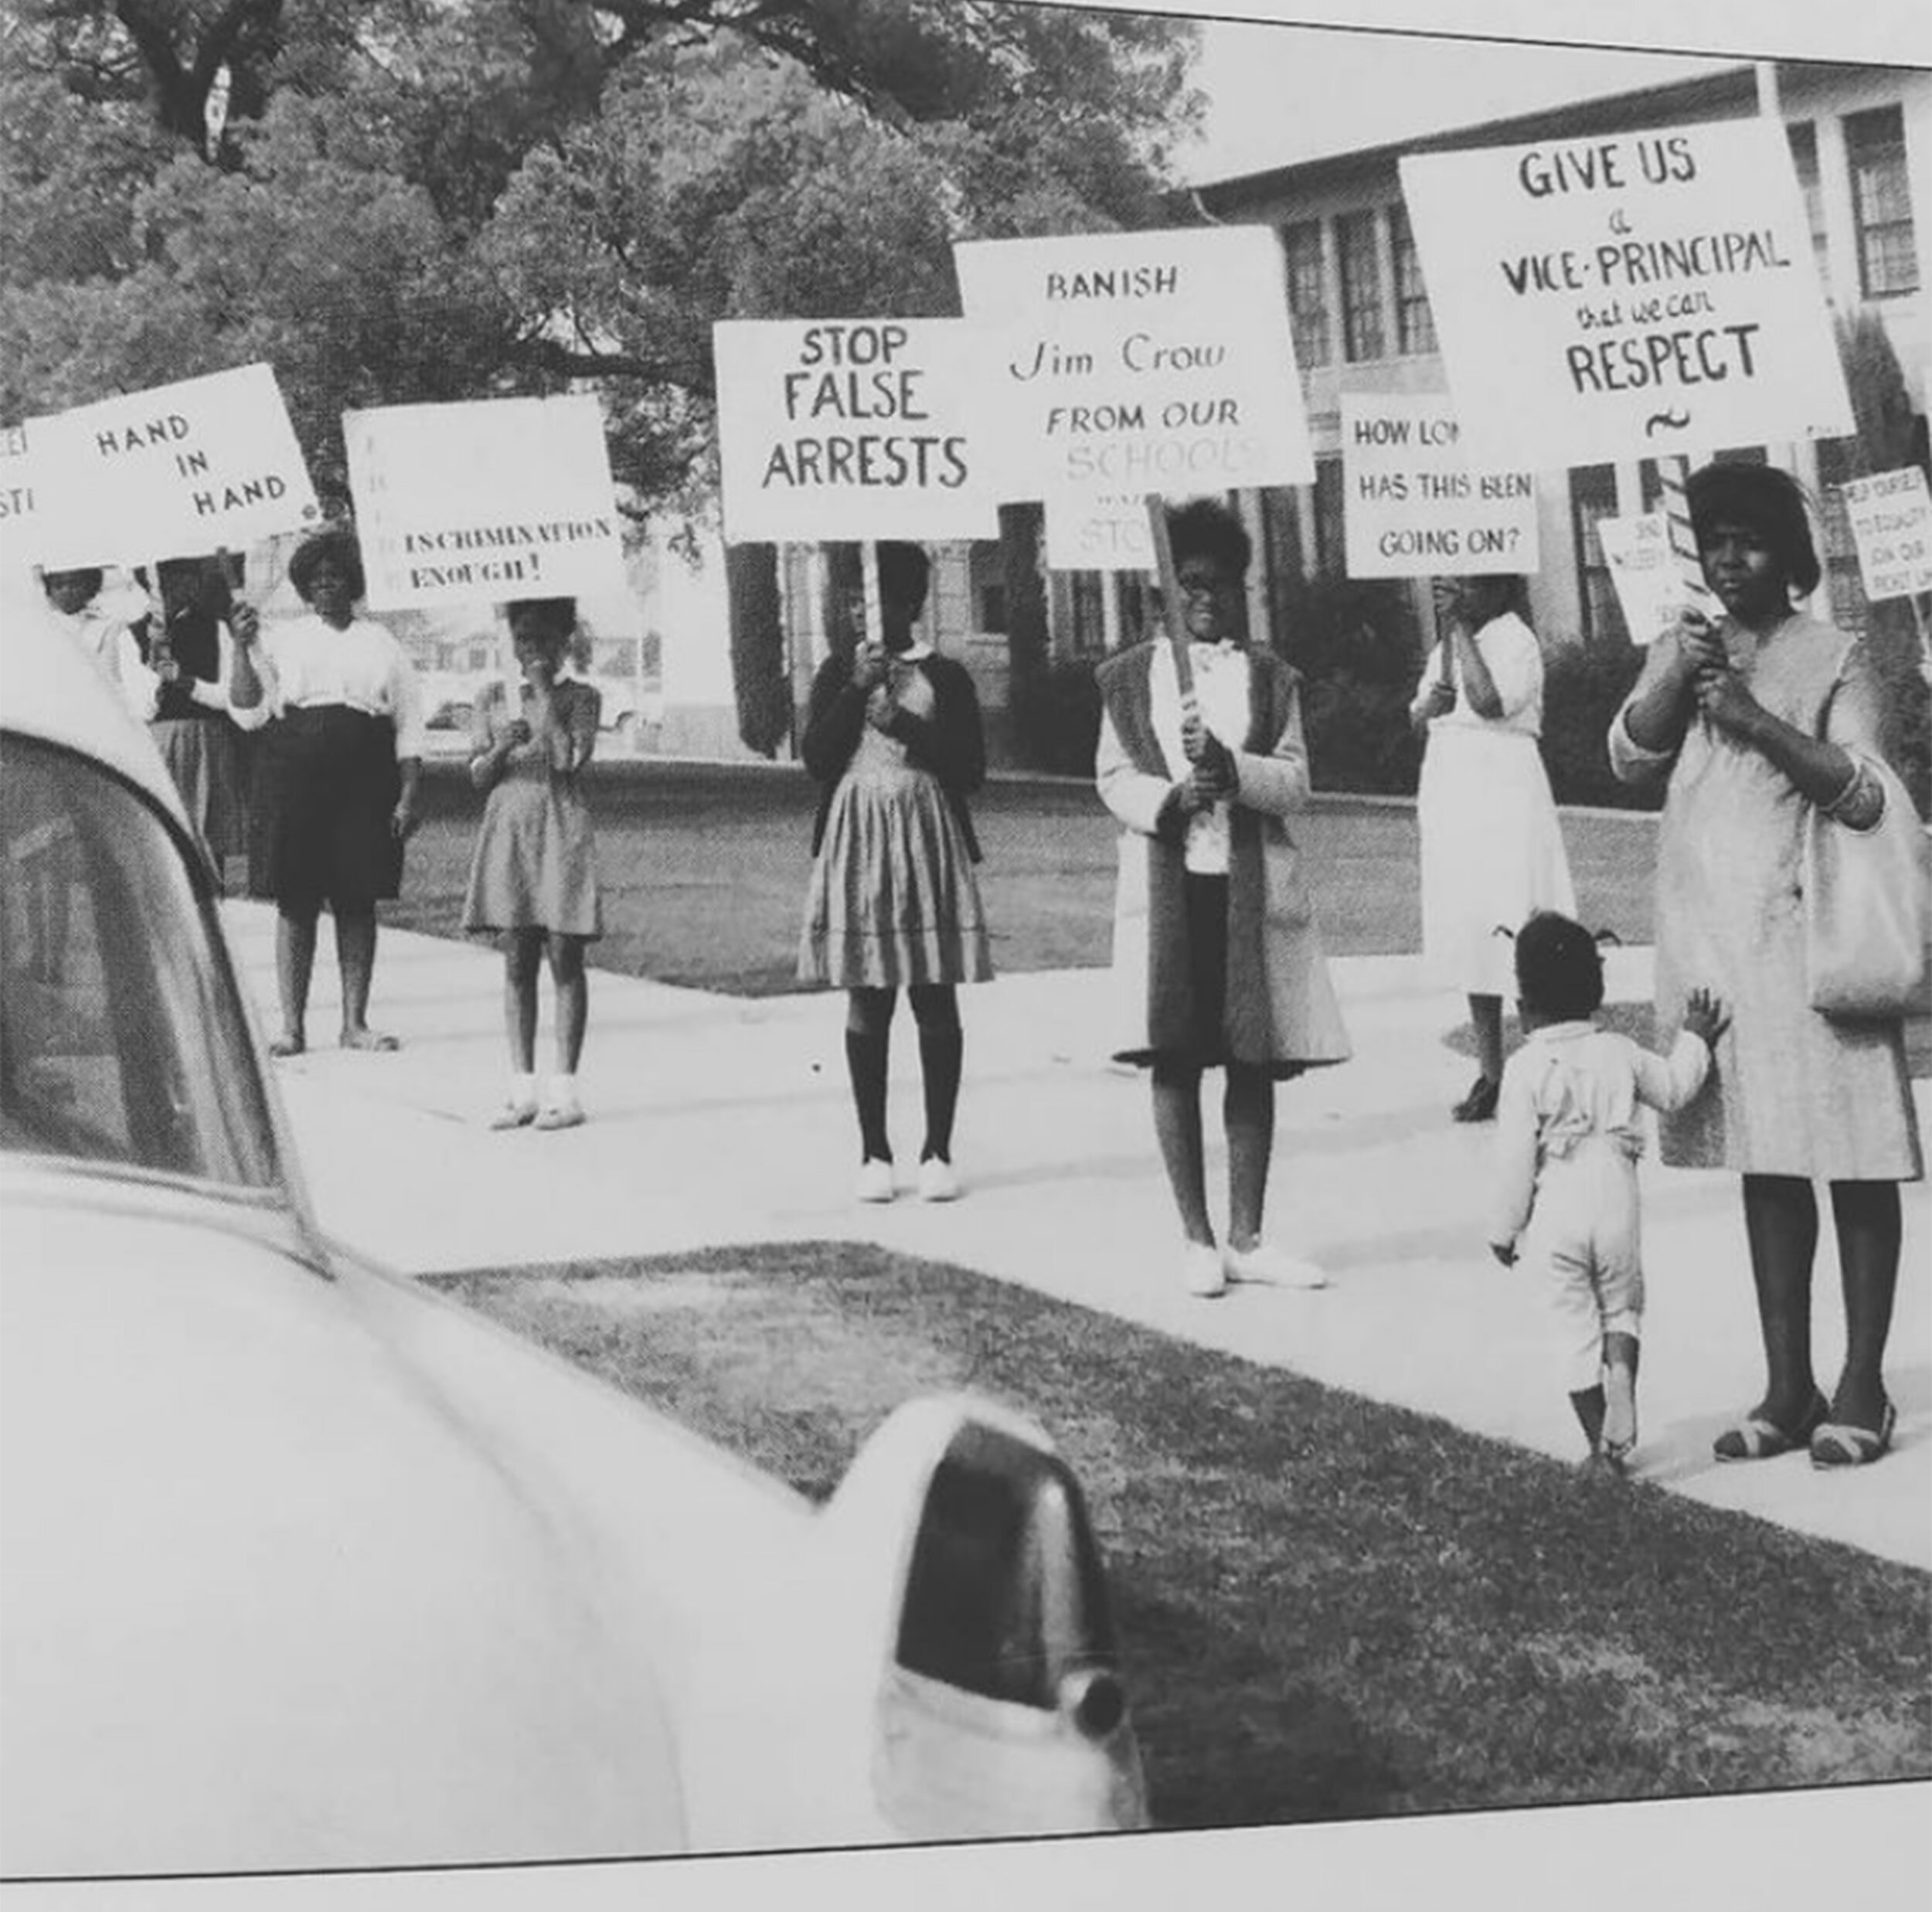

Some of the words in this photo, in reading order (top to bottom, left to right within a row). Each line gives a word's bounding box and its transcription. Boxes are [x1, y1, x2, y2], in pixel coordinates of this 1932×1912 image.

[1518, 143, 1626, 199] GIVE
[1637, 137, 1696, 185] US
[1609, 209, 1632, 235] a
[1046, 265, 1178, 300] BANISH
[1577, 301, 1624, 330] that
[1630, 298, 1663, 325] we
[1665, 290, 1716, 319] can
[800, 325, 909, 366] STOP
[1009, 342, 1094, 382] Jim
[1122, 333, 1226, 373] Crow
[1566, 324, 1760, 393] RESPECT
[784, 369, 930, 421] FALSE
[96, 414, 196, 456] HAND
[1046, 404, 1146, 435] FROM
[1162, 398, 1240, 429] OUR
[1354, 418, 1411, 447] HOW
[175, 450, 209, 478] IN
[762, 434, 968, 489] ARRESTS
[192, 475, 287, 516] HAND
[1359, 472, 1410, 502] HAS
[1416, 472, 1471, 500] THIS
[1479, 472, 1532, 501] BEEN
[1378, 529, 1461, 559] GOING
[1466, 526, 1522, 556] ON?
[410, 551, 542, 590] ENOUGH!
